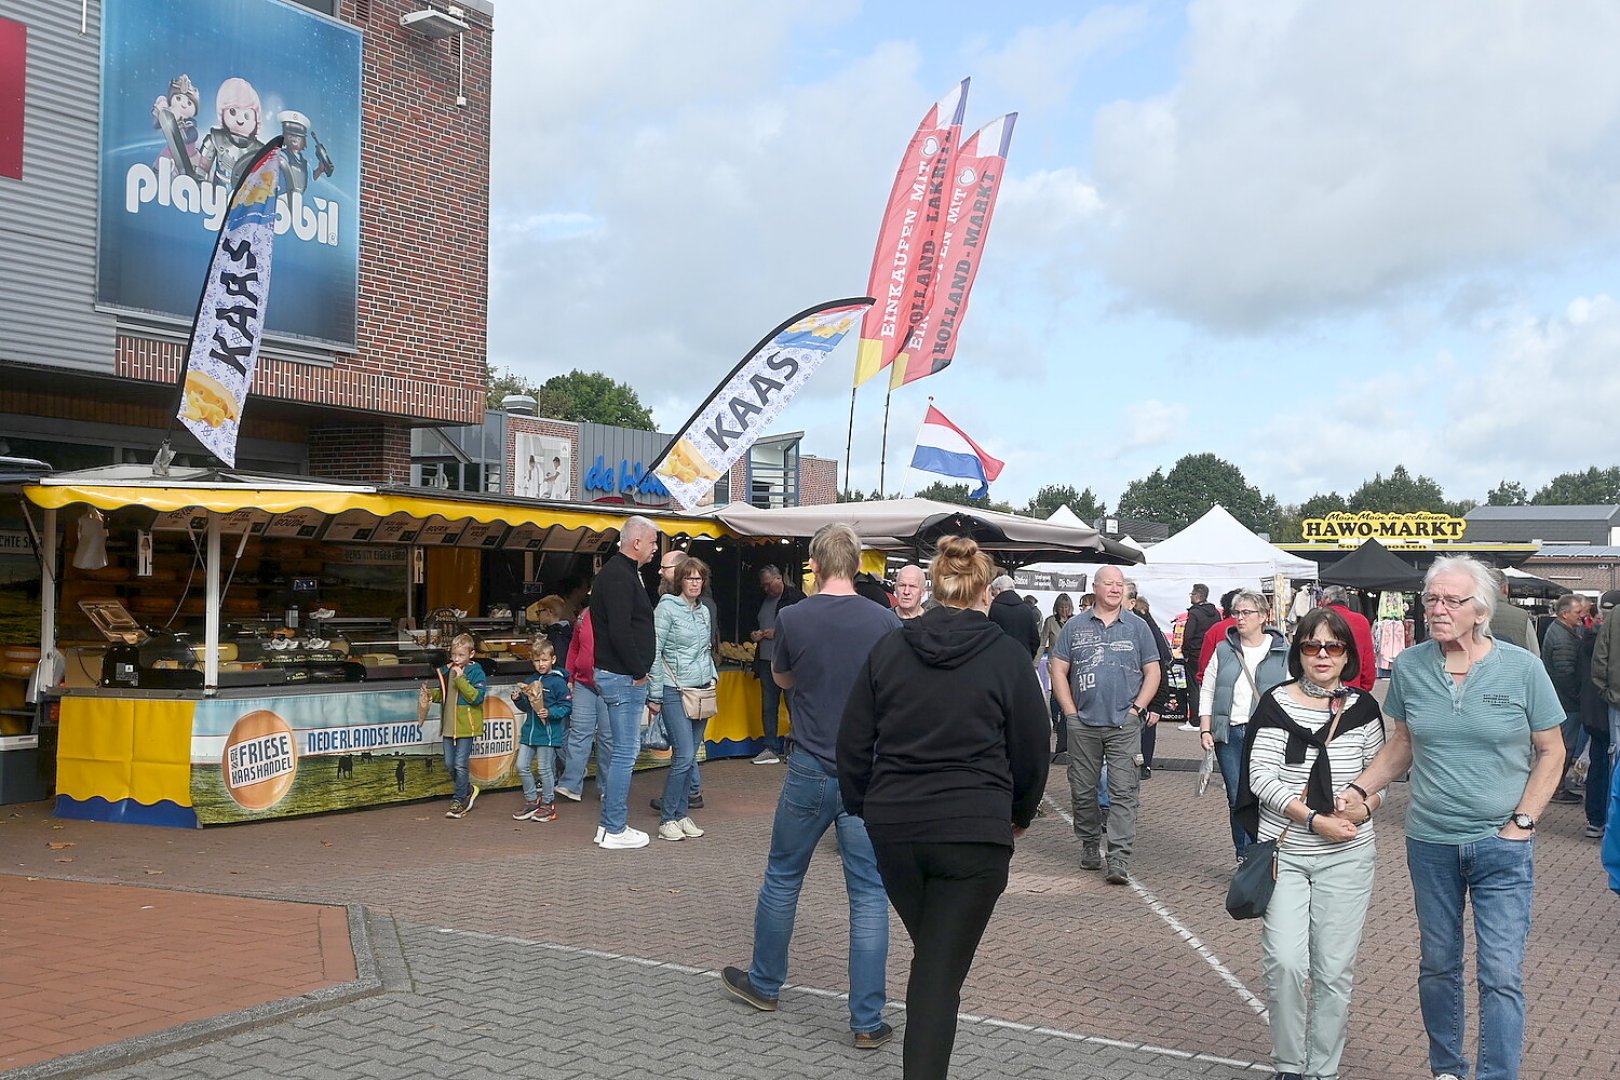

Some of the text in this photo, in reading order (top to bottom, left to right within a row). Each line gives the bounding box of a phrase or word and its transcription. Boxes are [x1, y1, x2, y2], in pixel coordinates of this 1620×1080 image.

[947, 188, 967, 224] MIT
[881, 160, 931, 338] EINKAUFEN MIT
[210, 238, 259, 378] KAAS
[704, 350, 799, 452] KAAS
[1306, 521, 1462, 537] HAWO-MARKT
[1328, 513, 1355, 521] Moin
[1357, 513, 1385, 521] Moin
[308, 724, 422, 753] NEDERLANDSE KAAS
[471, 721, 512, 742] RIESE
[239, 735, 289, 767] FRIESE
[469, 740, 513, 756] AASHANDEL
[232, 756, 293, 785] KAASHANDEL
